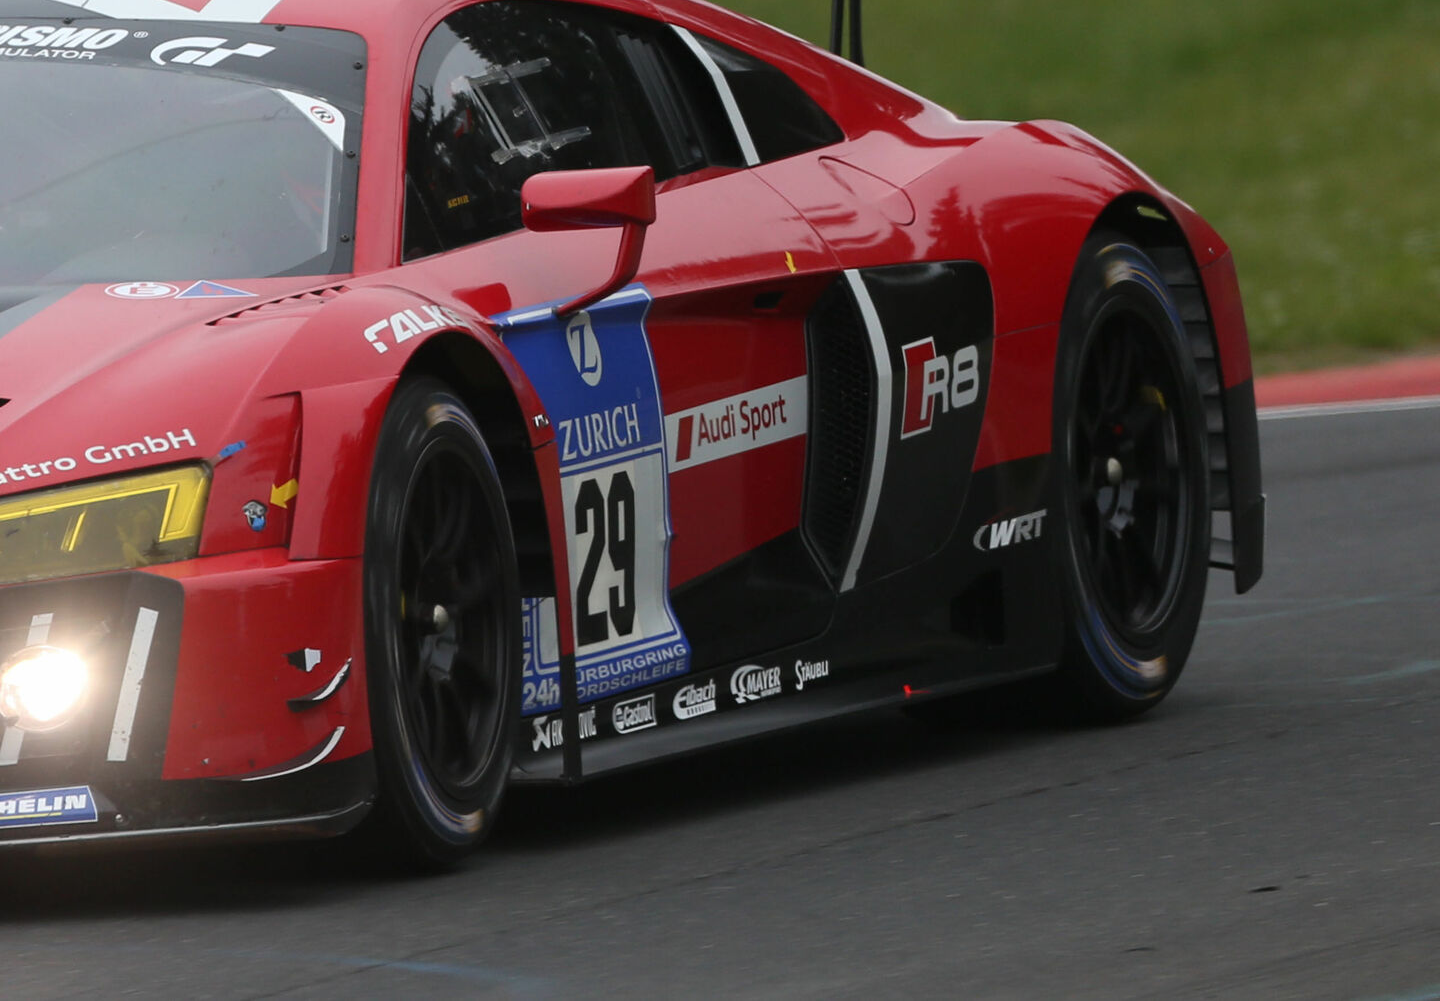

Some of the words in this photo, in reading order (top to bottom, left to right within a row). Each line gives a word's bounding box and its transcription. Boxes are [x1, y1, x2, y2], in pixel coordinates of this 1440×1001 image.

[920, 344, 980, 422] R8
[559, 403, 641, 462] ZURICH
[698, 406, 736, 446] Audi
[739, 395, 787, 440] Sport
[84, 428, 197, 464] GmbH
[988, 508, 1048, 550] WRT
[575, 471, 636, 647] 29
[576, 643, 688, 685] ÜRBURGRING
[577, 658, 686, 699] ORDSCHLEIFE
[746, 666, 781, 695] MAYER
